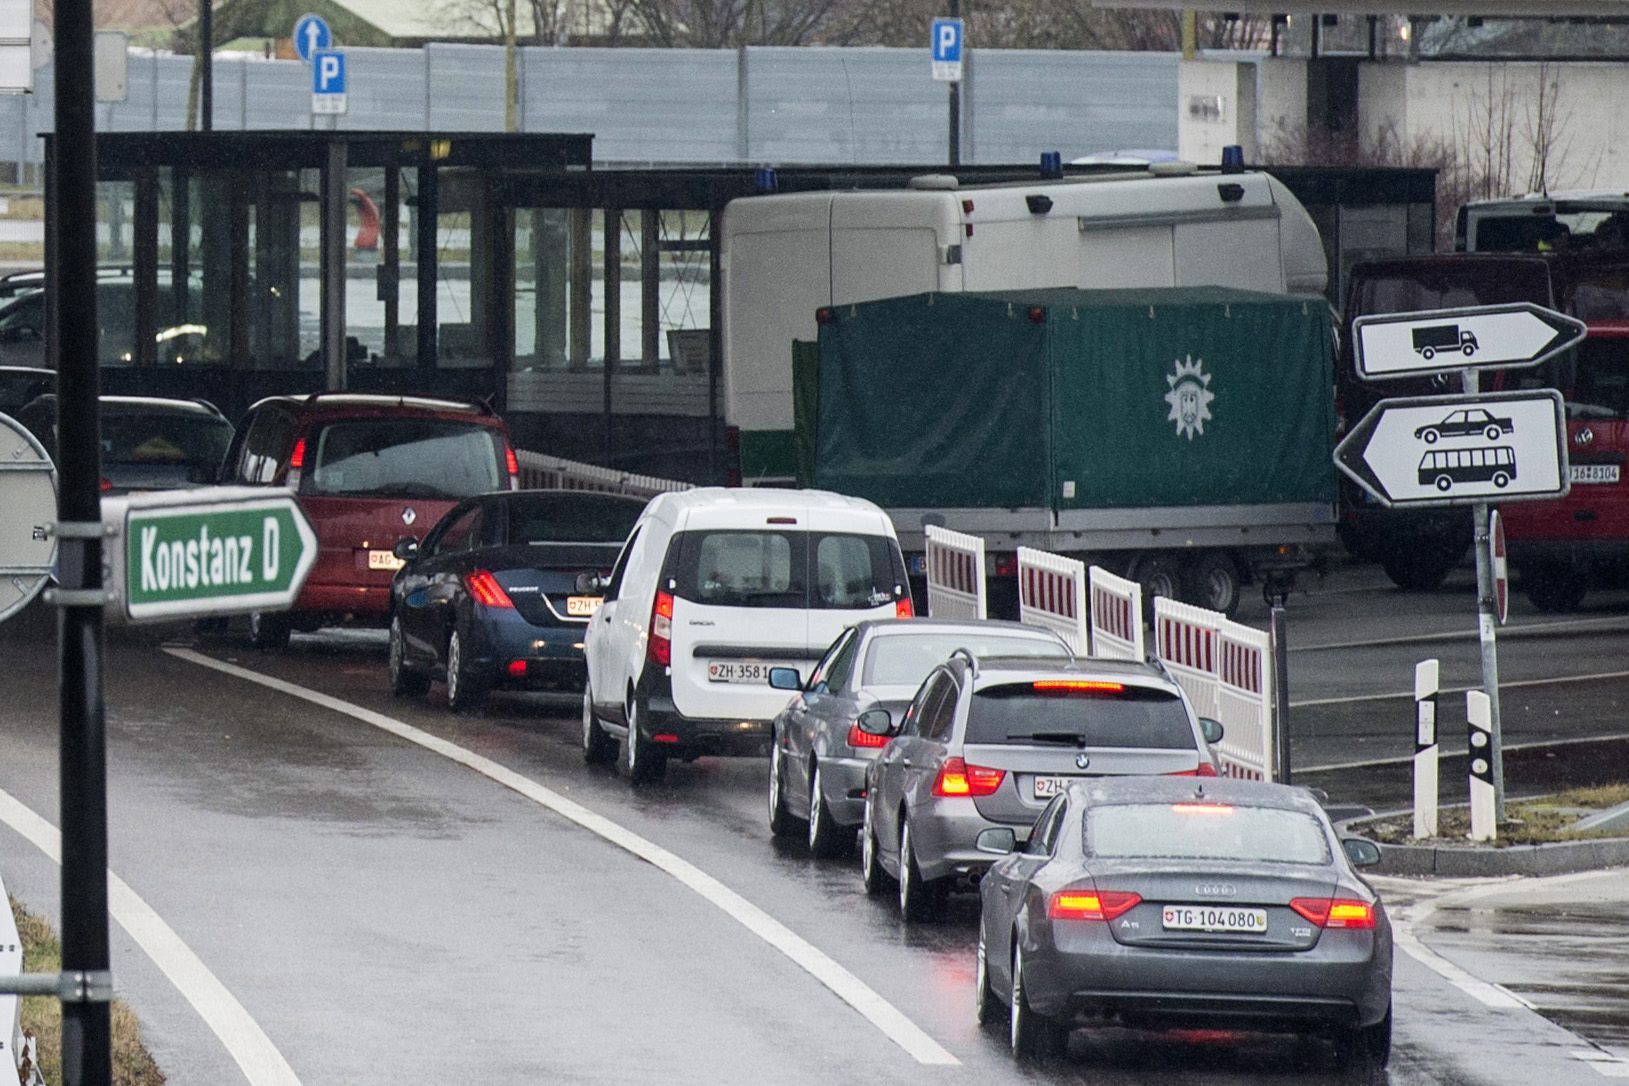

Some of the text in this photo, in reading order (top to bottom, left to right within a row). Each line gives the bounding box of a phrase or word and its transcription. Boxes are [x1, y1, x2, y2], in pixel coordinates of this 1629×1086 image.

[940, 25, 956, 58] P
[321, 56, 339, 90] P
[141, 516, 280, 592] Konstanz D
